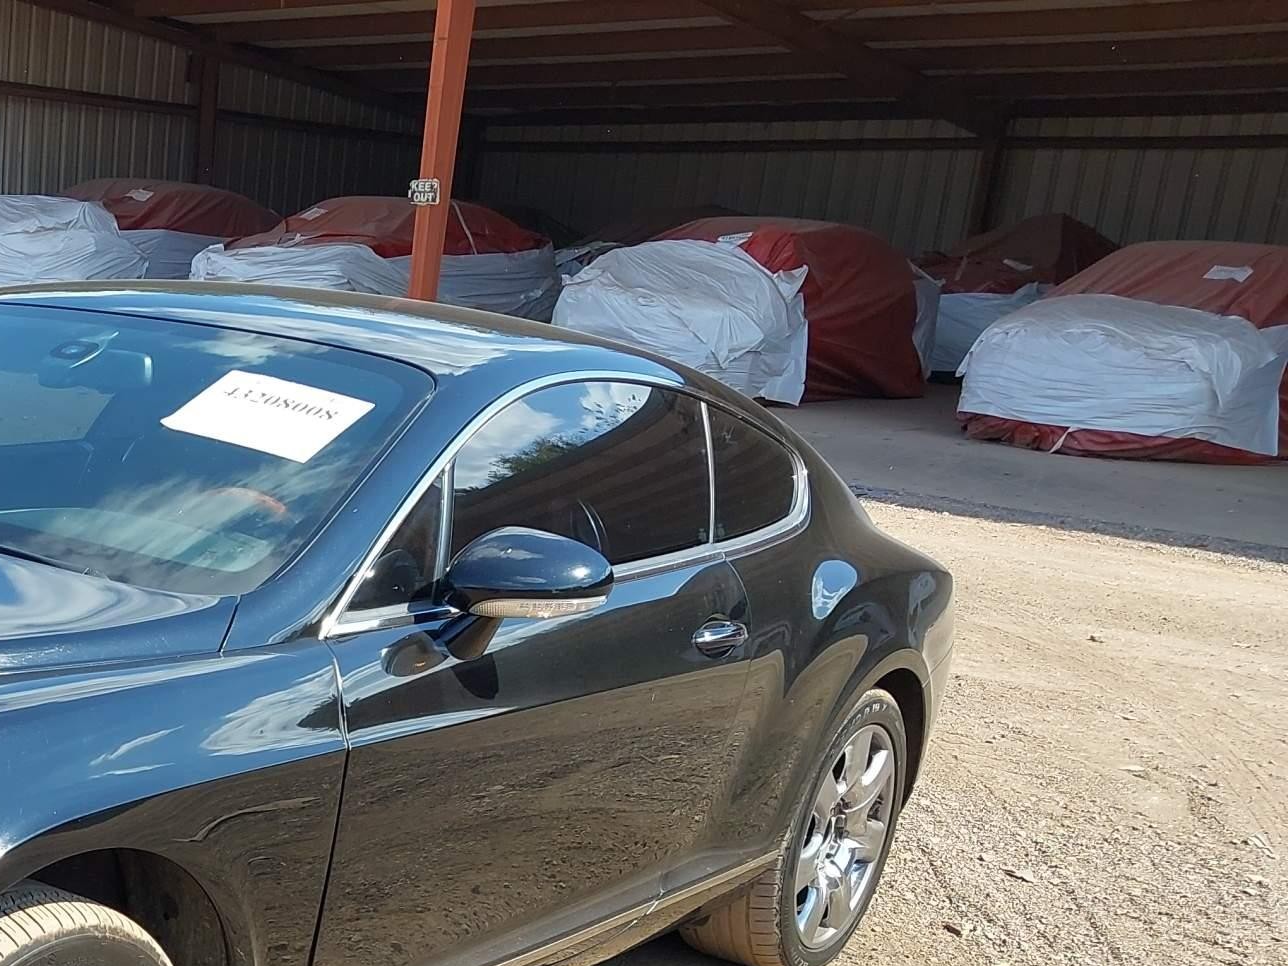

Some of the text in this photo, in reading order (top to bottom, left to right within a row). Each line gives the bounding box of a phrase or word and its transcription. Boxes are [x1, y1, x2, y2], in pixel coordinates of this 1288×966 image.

[411, 181, 437, 191] KEEP
[413, 192, 435, 202] OUT
[223, 386, 339, 420] 43208008
